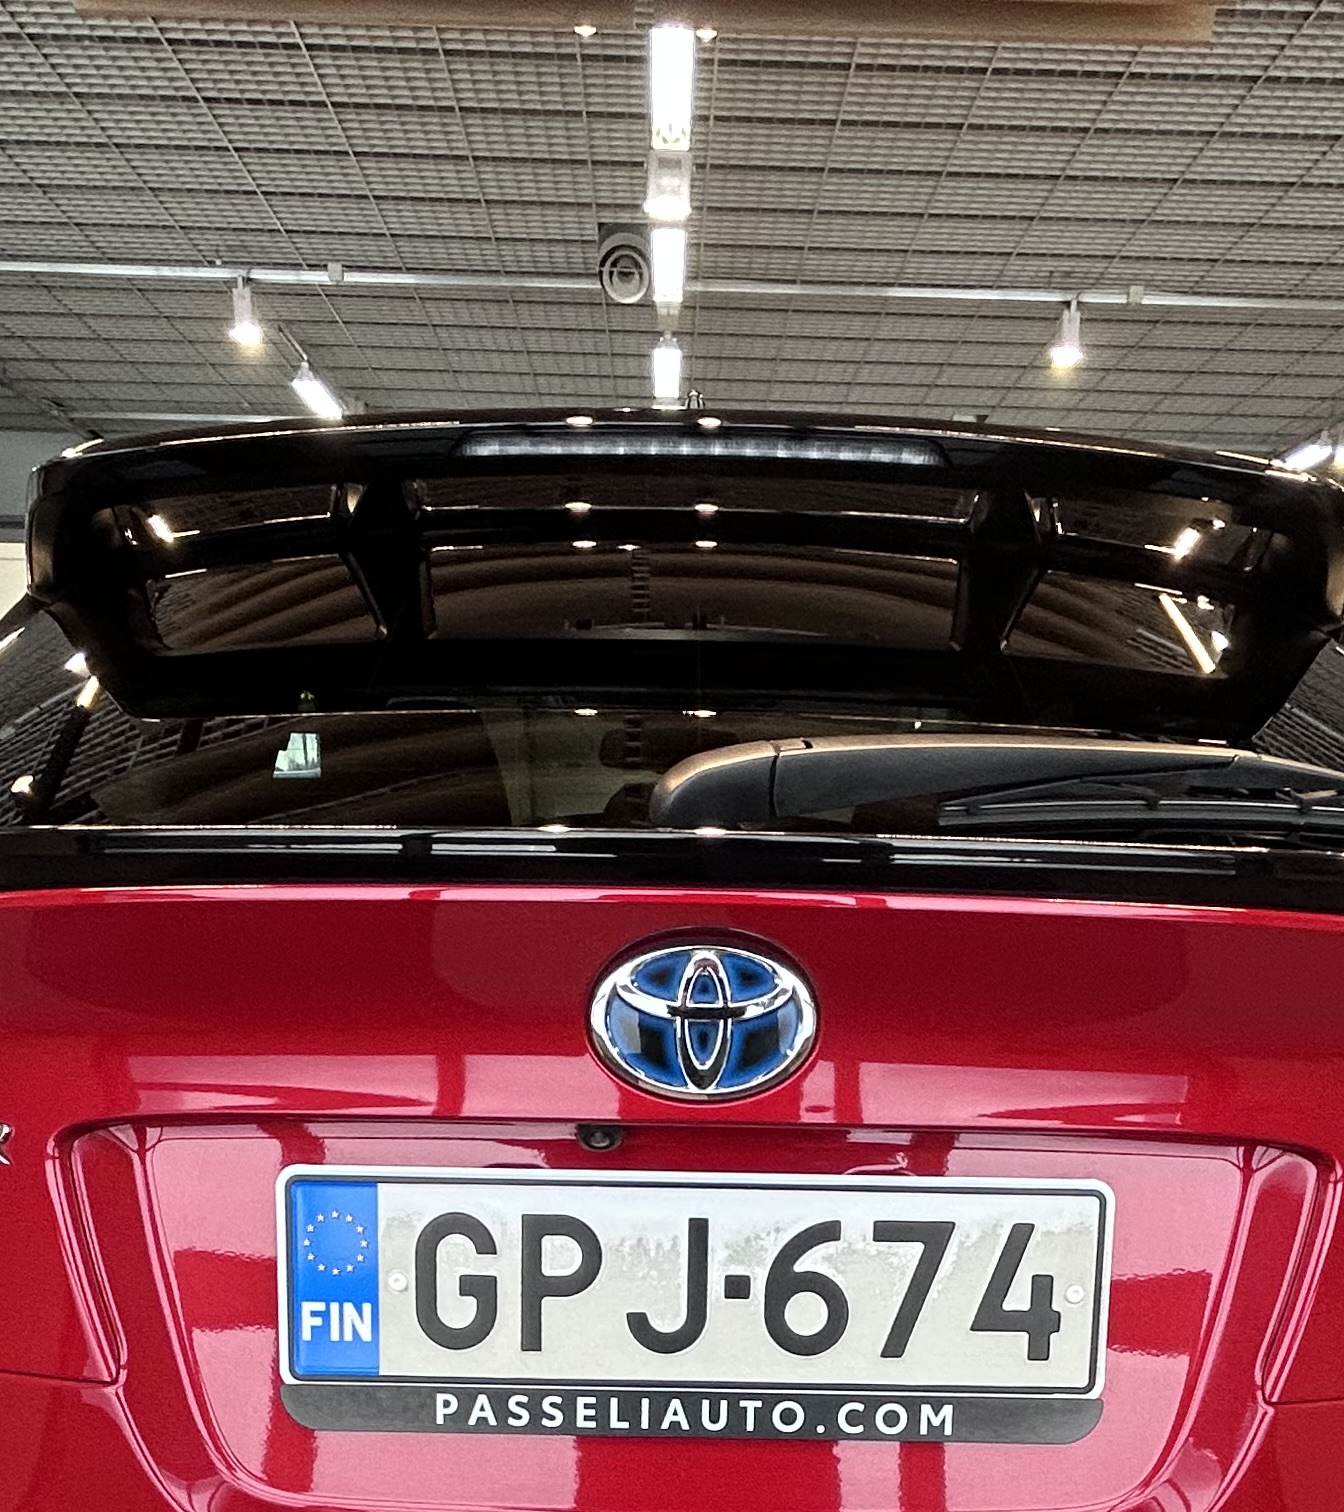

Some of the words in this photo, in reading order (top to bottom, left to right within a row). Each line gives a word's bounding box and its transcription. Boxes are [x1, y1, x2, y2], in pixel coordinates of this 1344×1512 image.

[413, 1212, 1062, 1362] GPJ-674
[301, 1300, 372, 1343] FIN
[435, 1392, 955, 1436] PASSELIAUTO.COM
